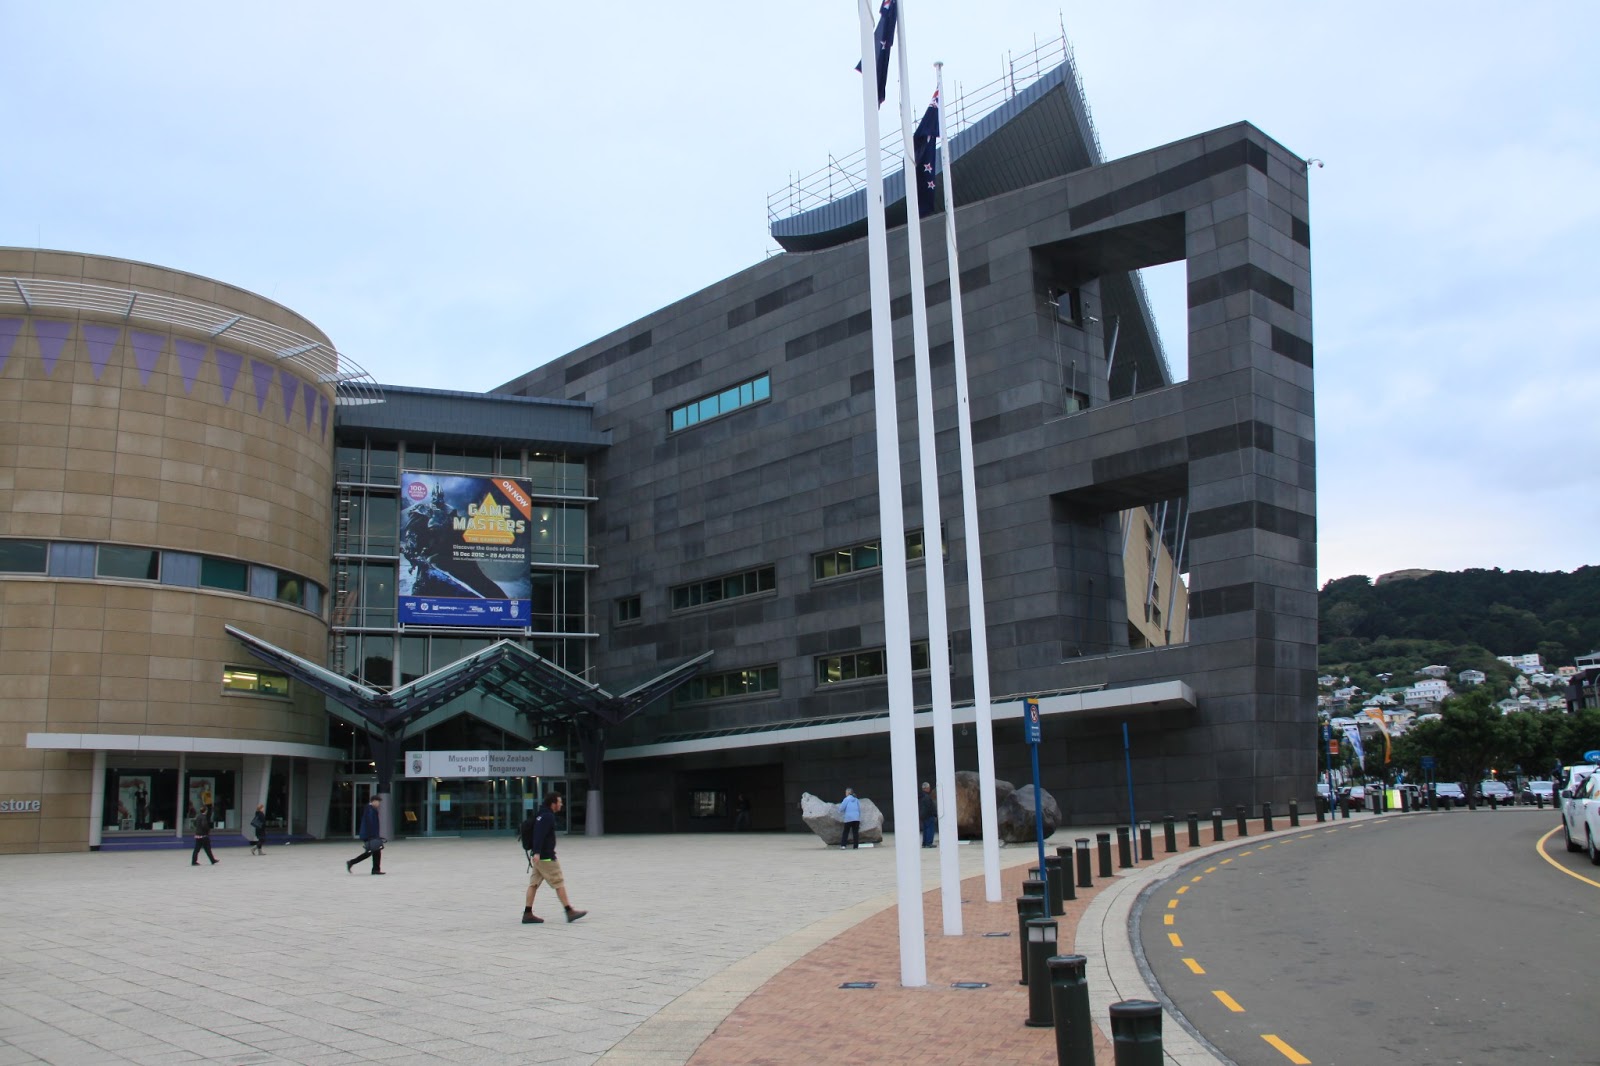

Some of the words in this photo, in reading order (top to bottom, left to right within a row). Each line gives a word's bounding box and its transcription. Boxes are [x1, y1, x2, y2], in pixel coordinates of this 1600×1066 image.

[502, 481, 514, 492] ON
[511, 490, 528, 507] NOW
[468, 503, 511, 518] GAME
[453, 517, 526, 533] MASTERS
[506, 754, 534, 762] Zealand
[468, 765, 486, 774] Papa
[489, 764, 526, 774] Tongarewa
[0, 799, 40, 811] store
